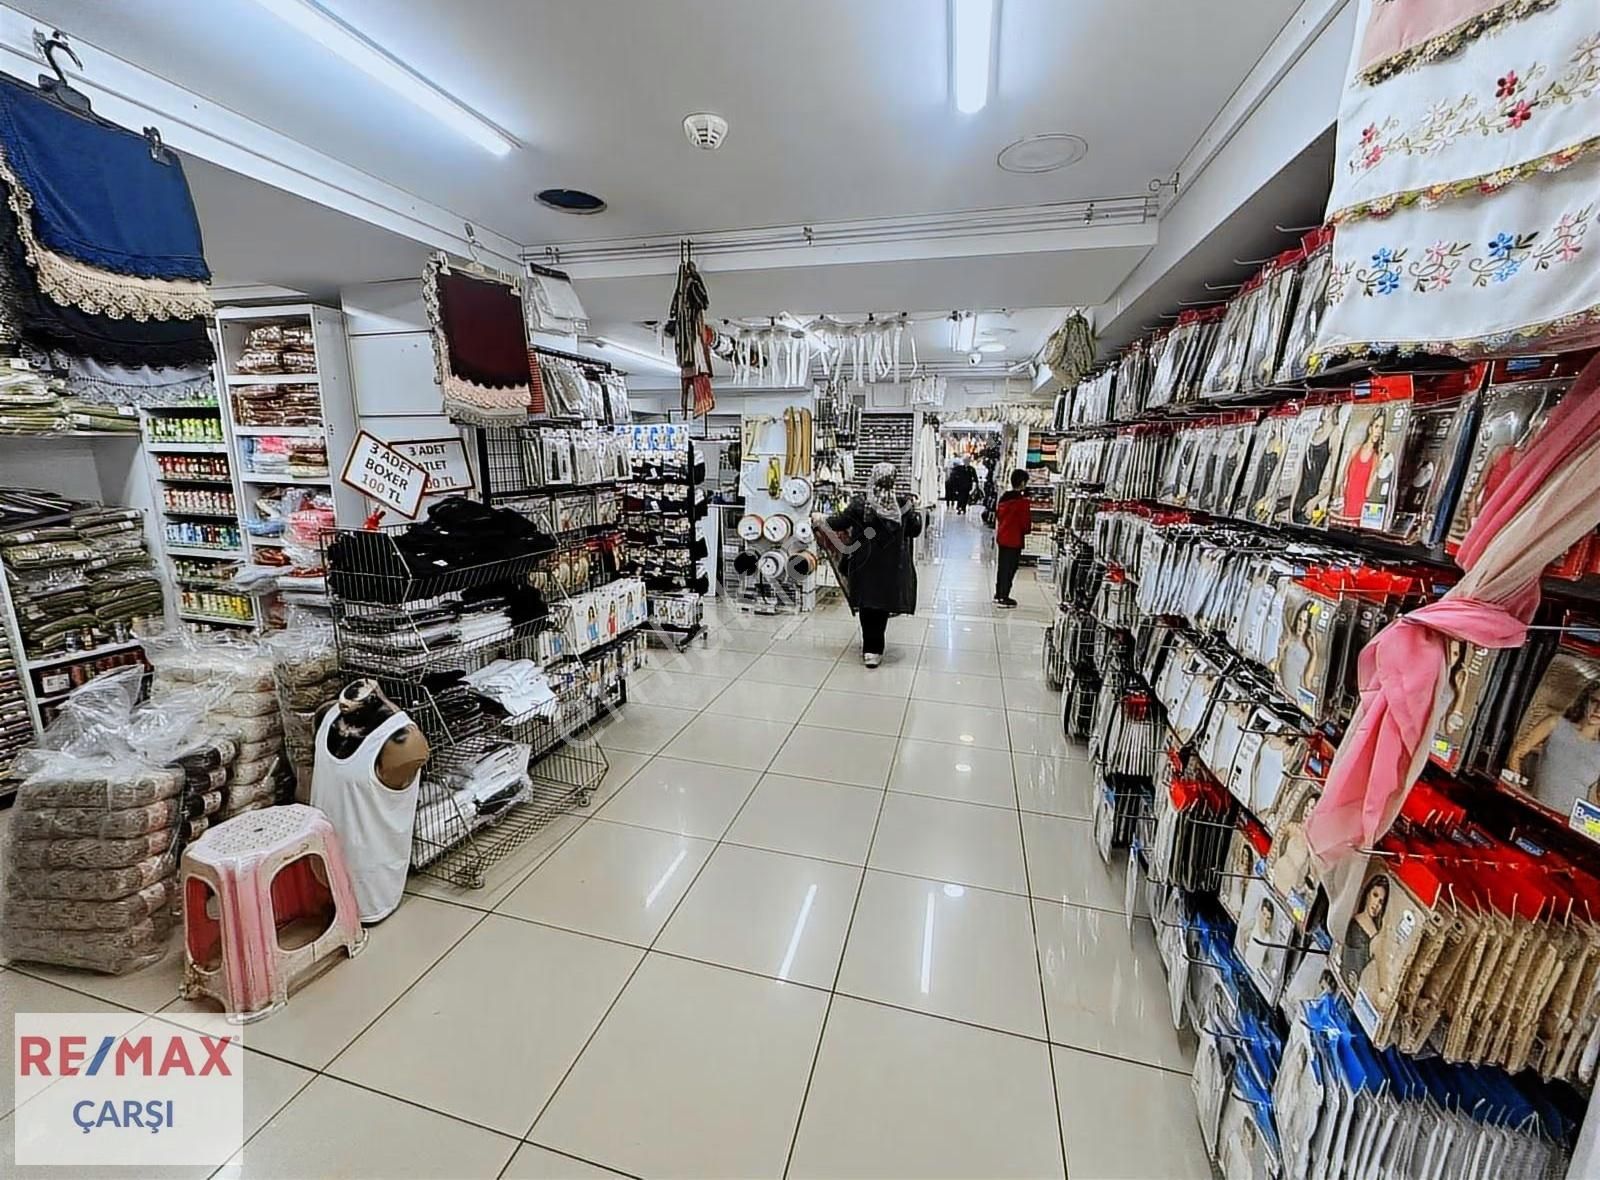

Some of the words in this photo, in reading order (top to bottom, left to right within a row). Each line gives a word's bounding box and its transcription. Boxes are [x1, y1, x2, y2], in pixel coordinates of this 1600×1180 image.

[369, 442, 379, 455] 3
[380, 451, 415, 476] ADET
[409, 447, 417, 457] 3
[419, 444, 446, 456] ADET
[361, 473, 385, 494] 100
[388, 488, 402, 504] TL
[365, 457, 409, 491] BOXER
[441, 476, 457, 487] TL
